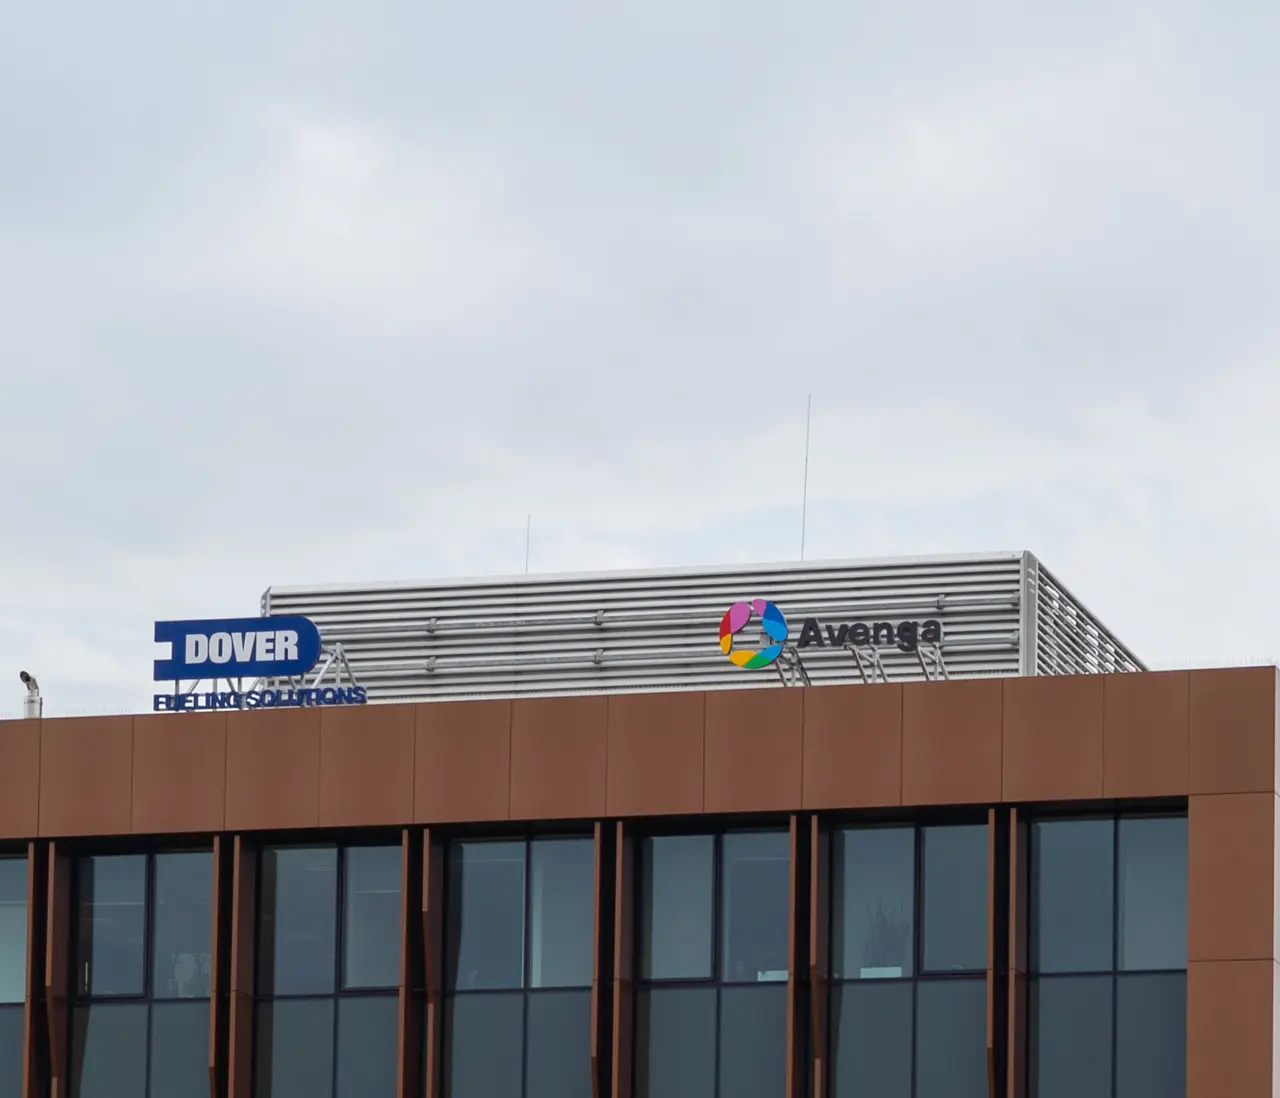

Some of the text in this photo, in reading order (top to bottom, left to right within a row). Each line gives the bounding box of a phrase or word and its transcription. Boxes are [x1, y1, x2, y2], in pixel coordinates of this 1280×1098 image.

[185, 630, 299, 664] DOVER
[797, 617, 942, 653] Avenga
[153, 686, 368, 711] FUELING SOLUTIONS
